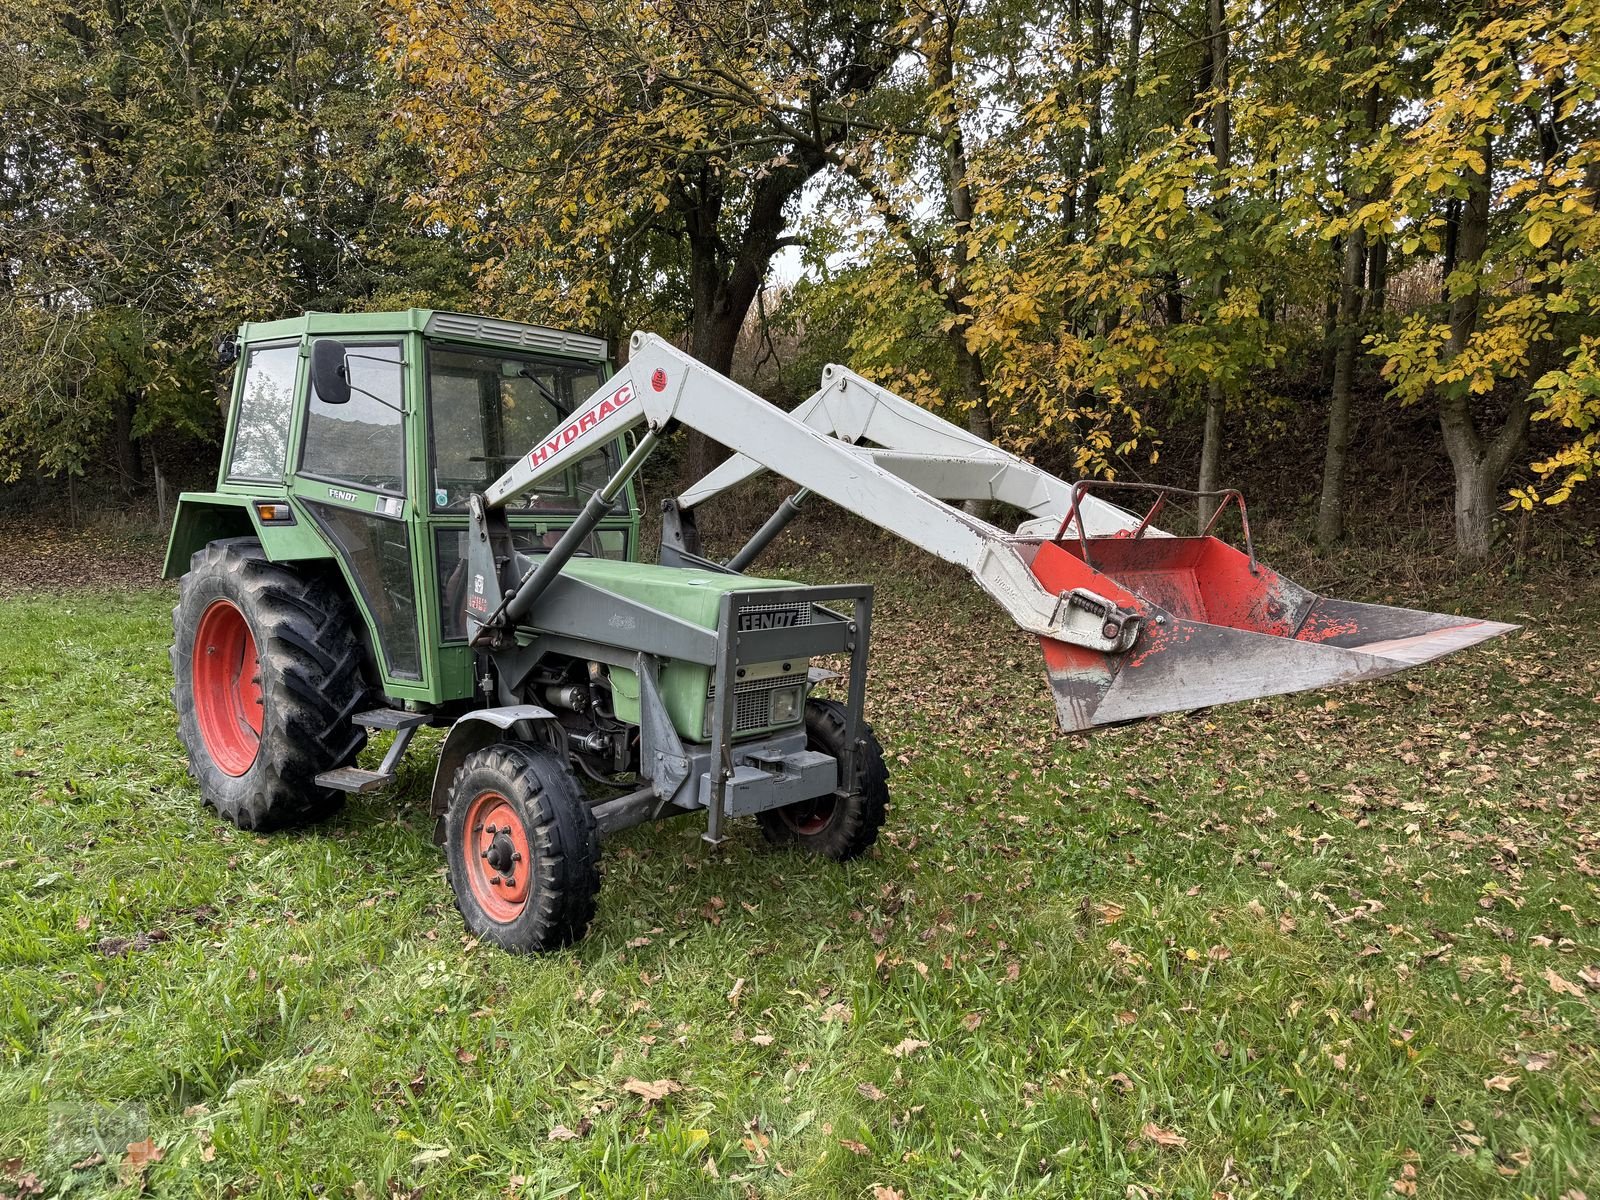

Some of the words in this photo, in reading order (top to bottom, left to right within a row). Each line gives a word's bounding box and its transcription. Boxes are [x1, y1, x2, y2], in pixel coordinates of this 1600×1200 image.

[531, 386, 631, 467] HYDRAC
[328, 488, 359, 502] FENDT
[741, 611, 797, 631] FENDT
